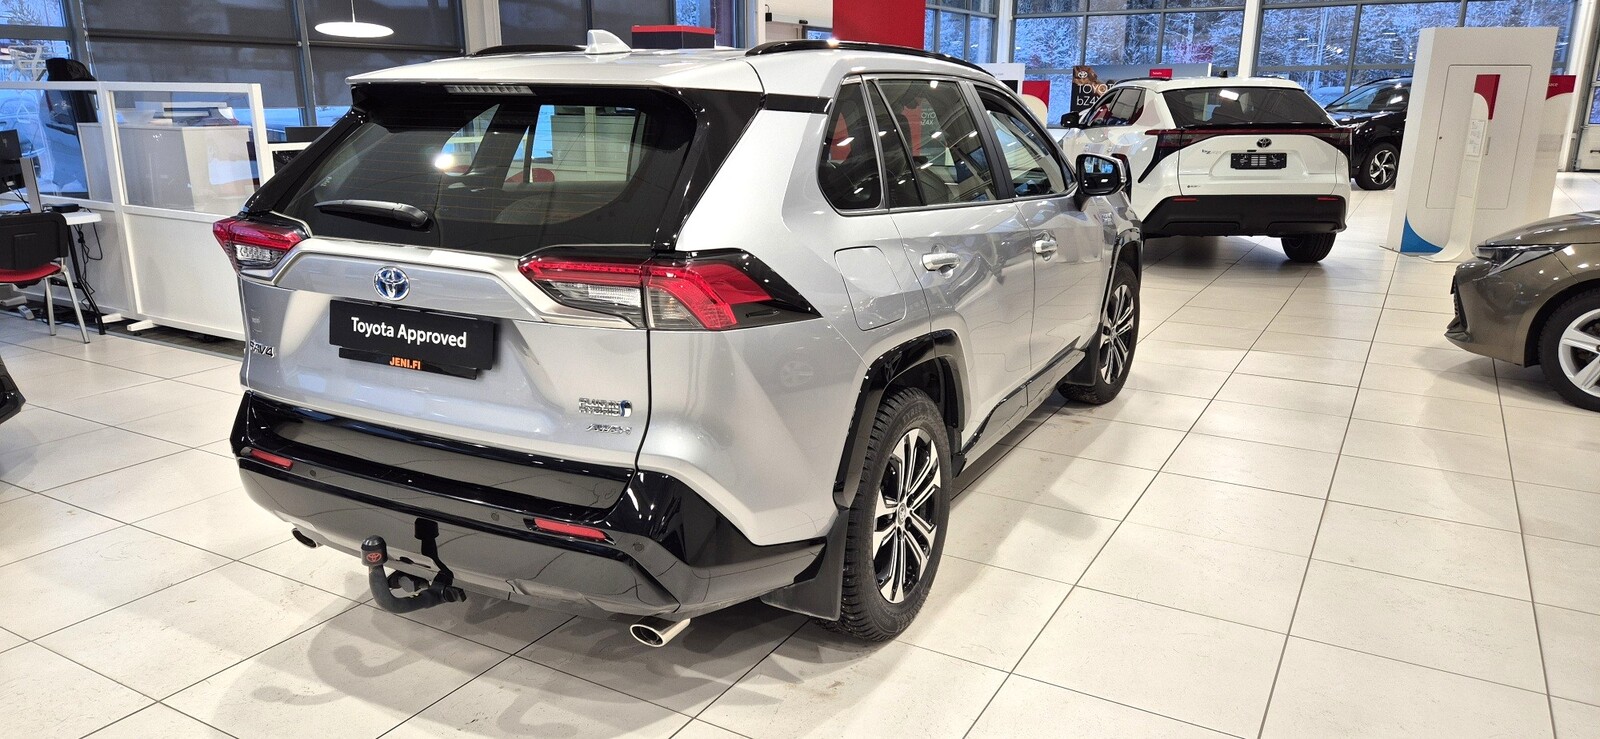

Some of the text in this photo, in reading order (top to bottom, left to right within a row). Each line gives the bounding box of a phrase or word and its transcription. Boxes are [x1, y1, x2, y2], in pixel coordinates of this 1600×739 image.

[1077, 83, 1114, 94] TOYOT
[351, 316, 468, 349] Toyota Approved
[249, 339, 275, 358] RAV4
[390, 357, 421, 370] JENI.FI
